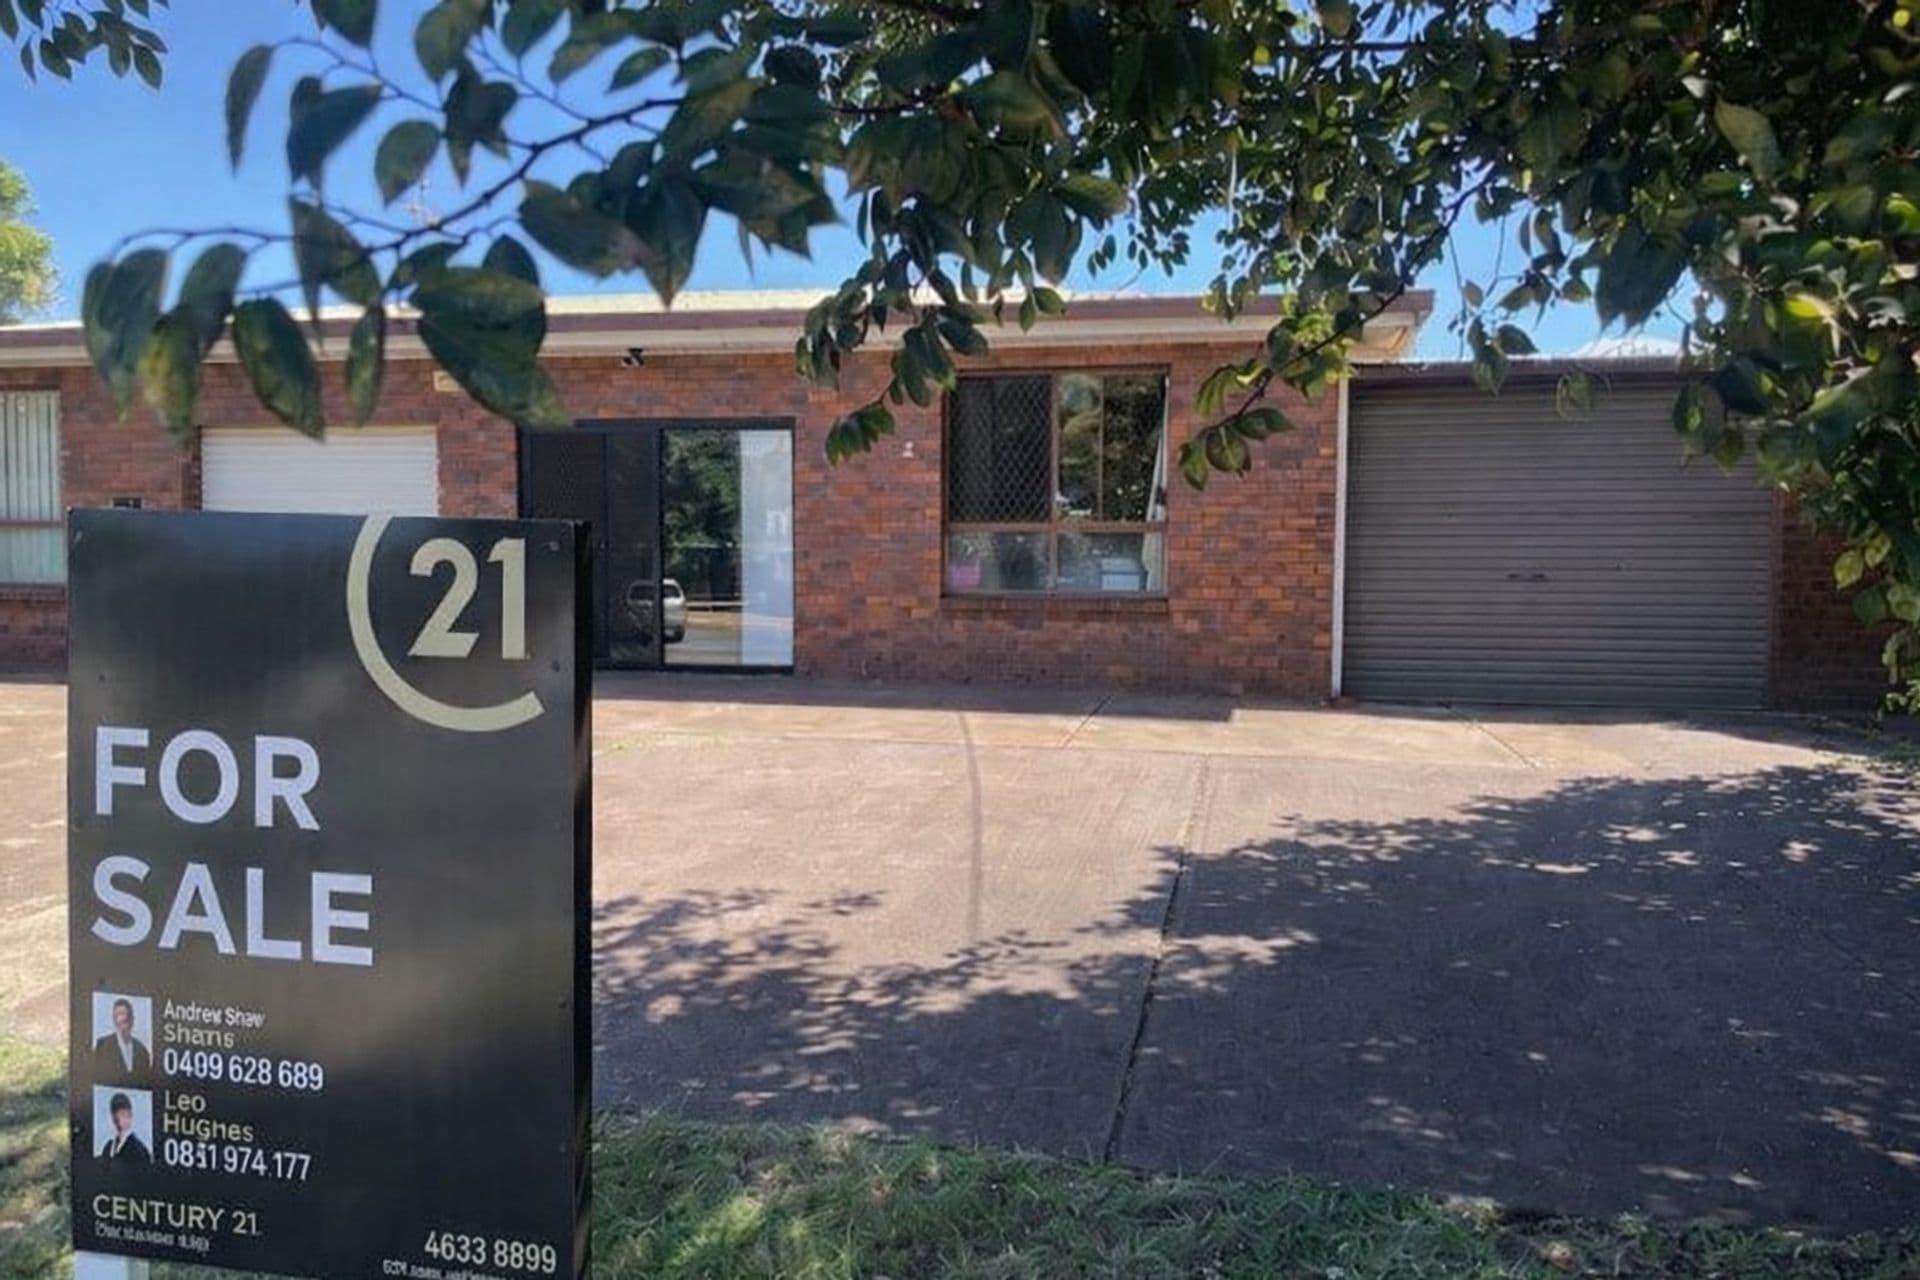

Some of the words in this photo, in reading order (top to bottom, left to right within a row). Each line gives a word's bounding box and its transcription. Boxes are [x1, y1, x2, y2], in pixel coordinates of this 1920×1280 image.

[409, 538, 526, 659] 21
[95, 726, 320, 831] FOR
[92, 855, 373, 966] SALE
[229, 1055, 272, 1084] 628
[278, 1060, 324, 1091] 689
[164, 1090, 206, 1113] Leo
[223, 1145, 267, 1176] 974
[272, 1151, 312, 1181] 177
[92, 1194, 225, 1231] CENTURY
[231, 1211, 258, 1235] 21
[424, 1230, 487, 1265] 4633
[494, 1239, 557, 1274] 8899
